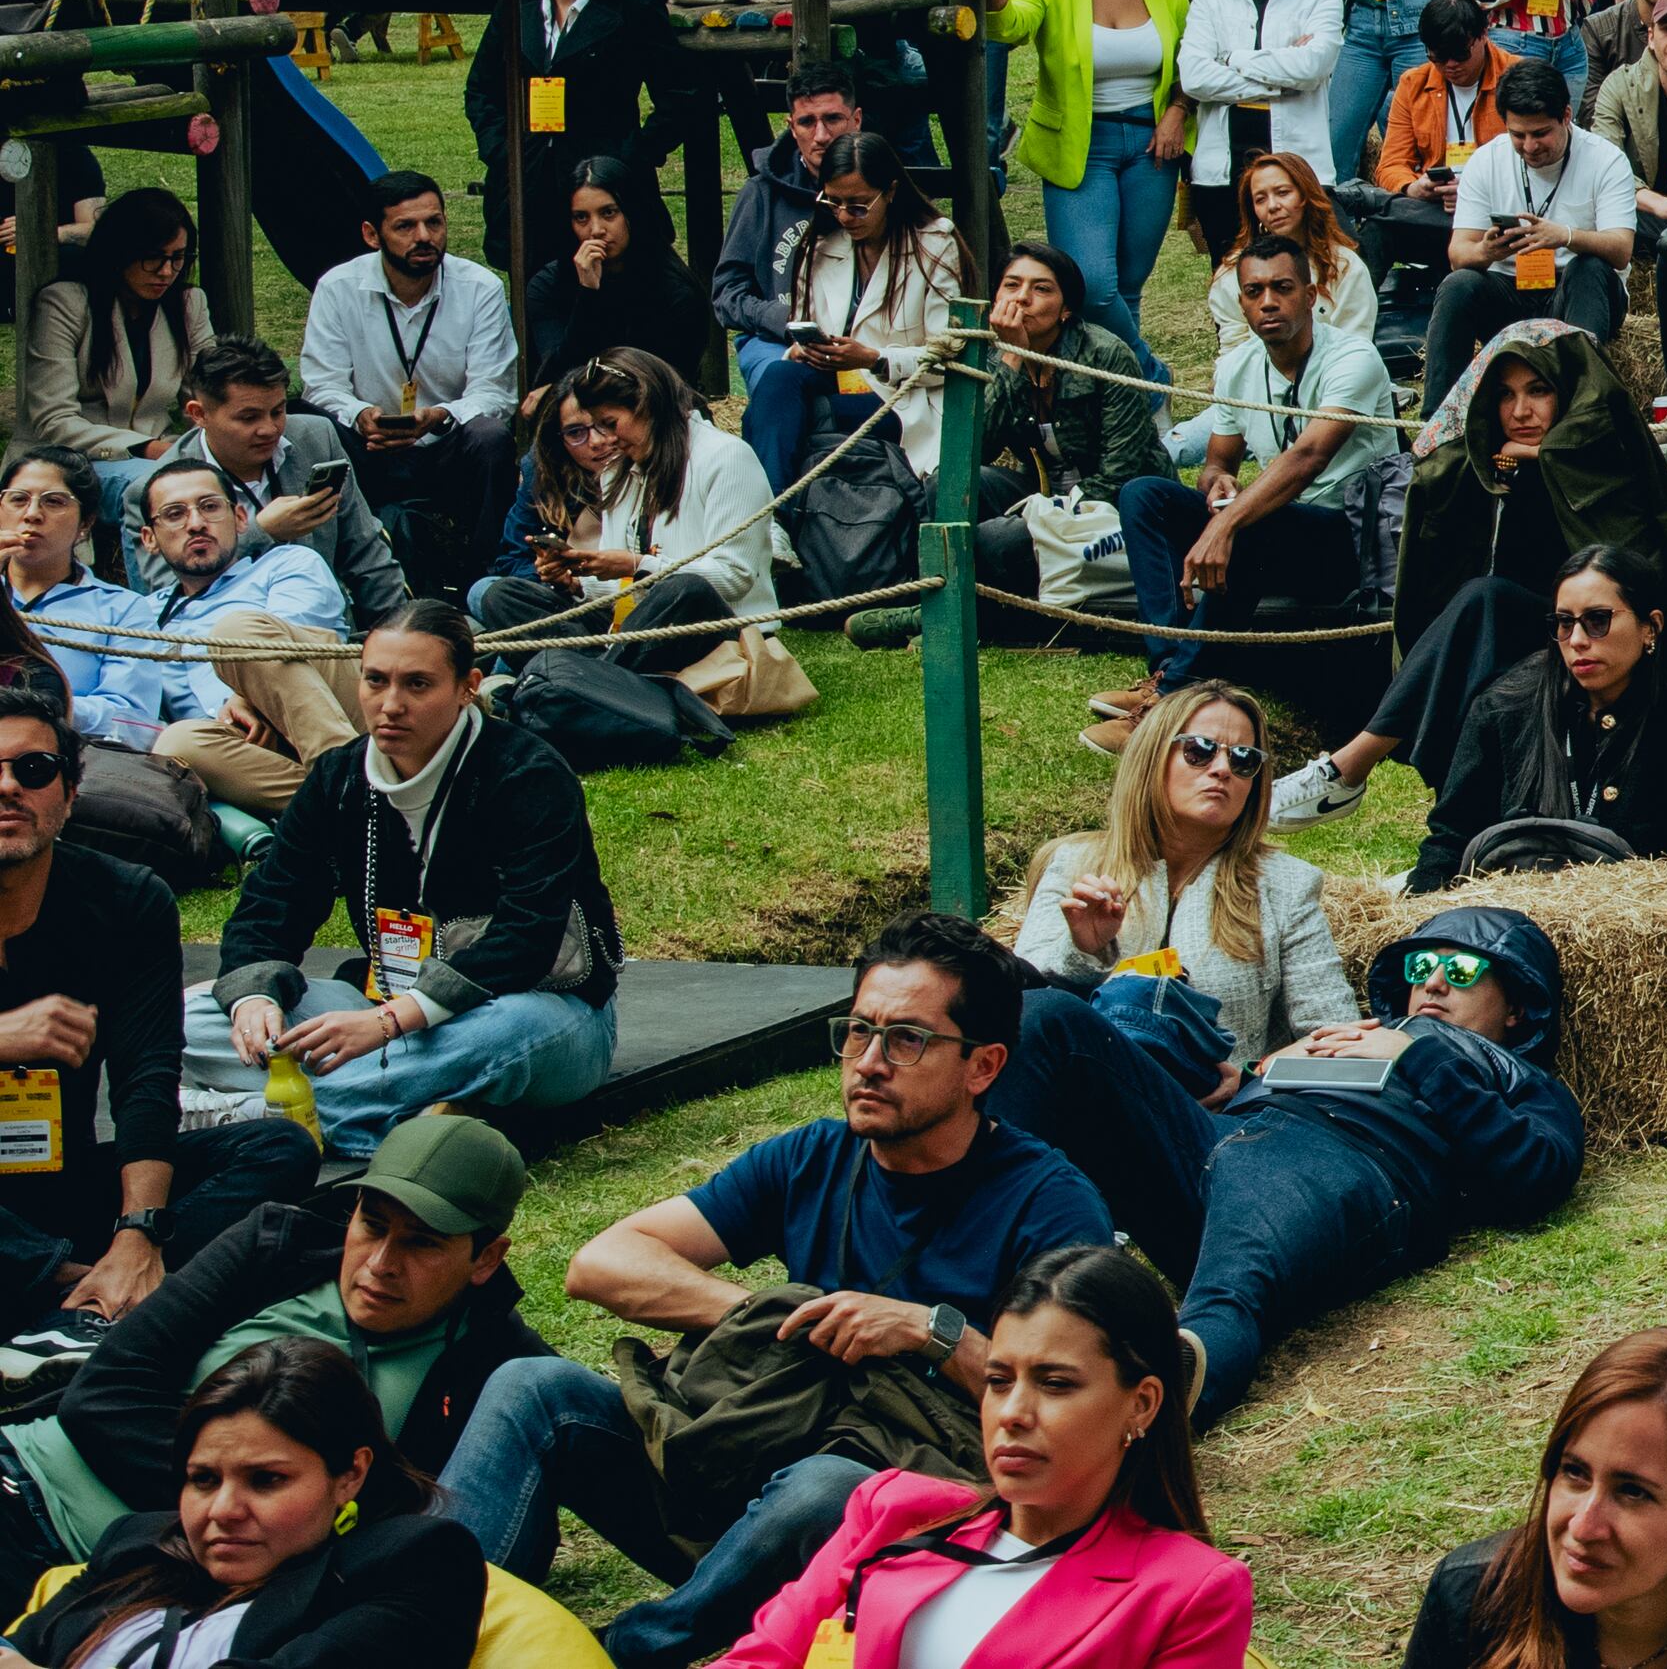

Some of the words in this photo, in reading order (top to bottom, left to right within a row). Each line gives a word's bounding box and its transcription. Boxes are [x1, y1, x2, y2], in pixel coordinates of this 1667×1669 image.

[389, 922, 414, 932] HELLO
[384, 933, 416, 946] startup
[395, 942, 418, 955] grind
